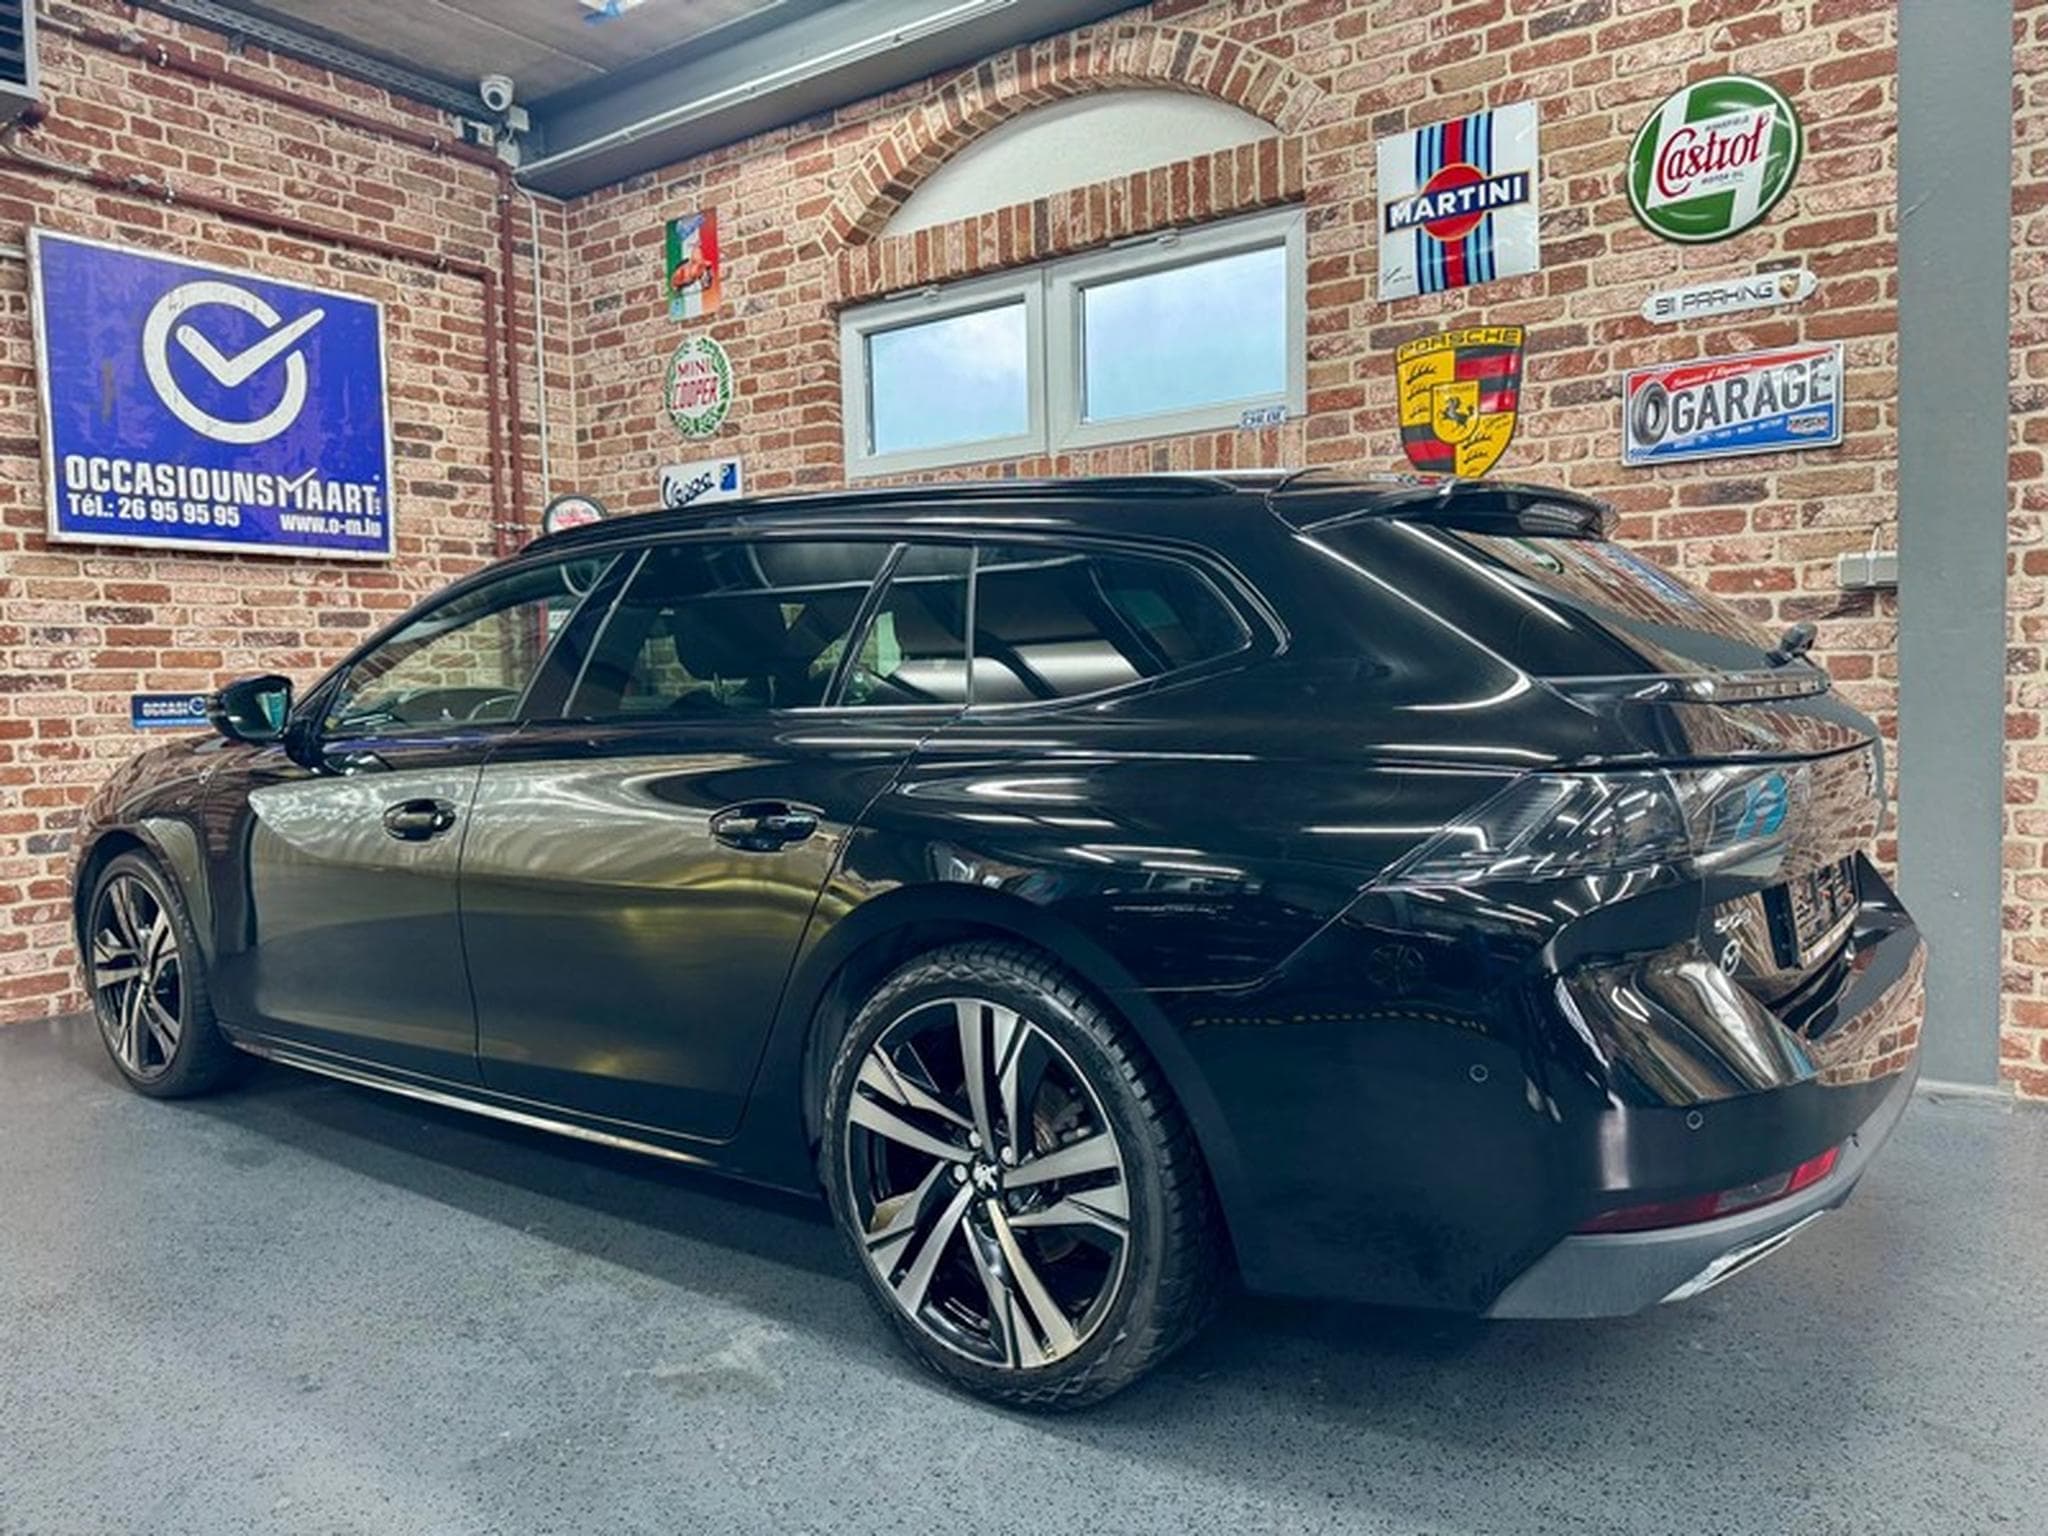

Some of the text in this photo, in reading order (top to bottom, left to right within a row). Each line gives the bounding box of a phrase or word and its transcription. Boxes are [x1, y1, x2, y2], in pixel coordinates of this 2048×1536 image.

[1656, 114, 1769, 198] Castrol
[1389, 176, 1522, 227] MARTINI
[1682, 280, 1774, 311] PARKING
[1400, 329, 1519, 358] PORSCHE
[677, 357, 711, 378] MINI
[673, 377, 718, 410] COOPER
[1671, 355, 1834, 436] GARAGE
[118, 498, 147, 519] 26
[150, 500, 178, 523] 95
[183, 503, 210, 526] 95
[214, 505, 240, 528] 95
